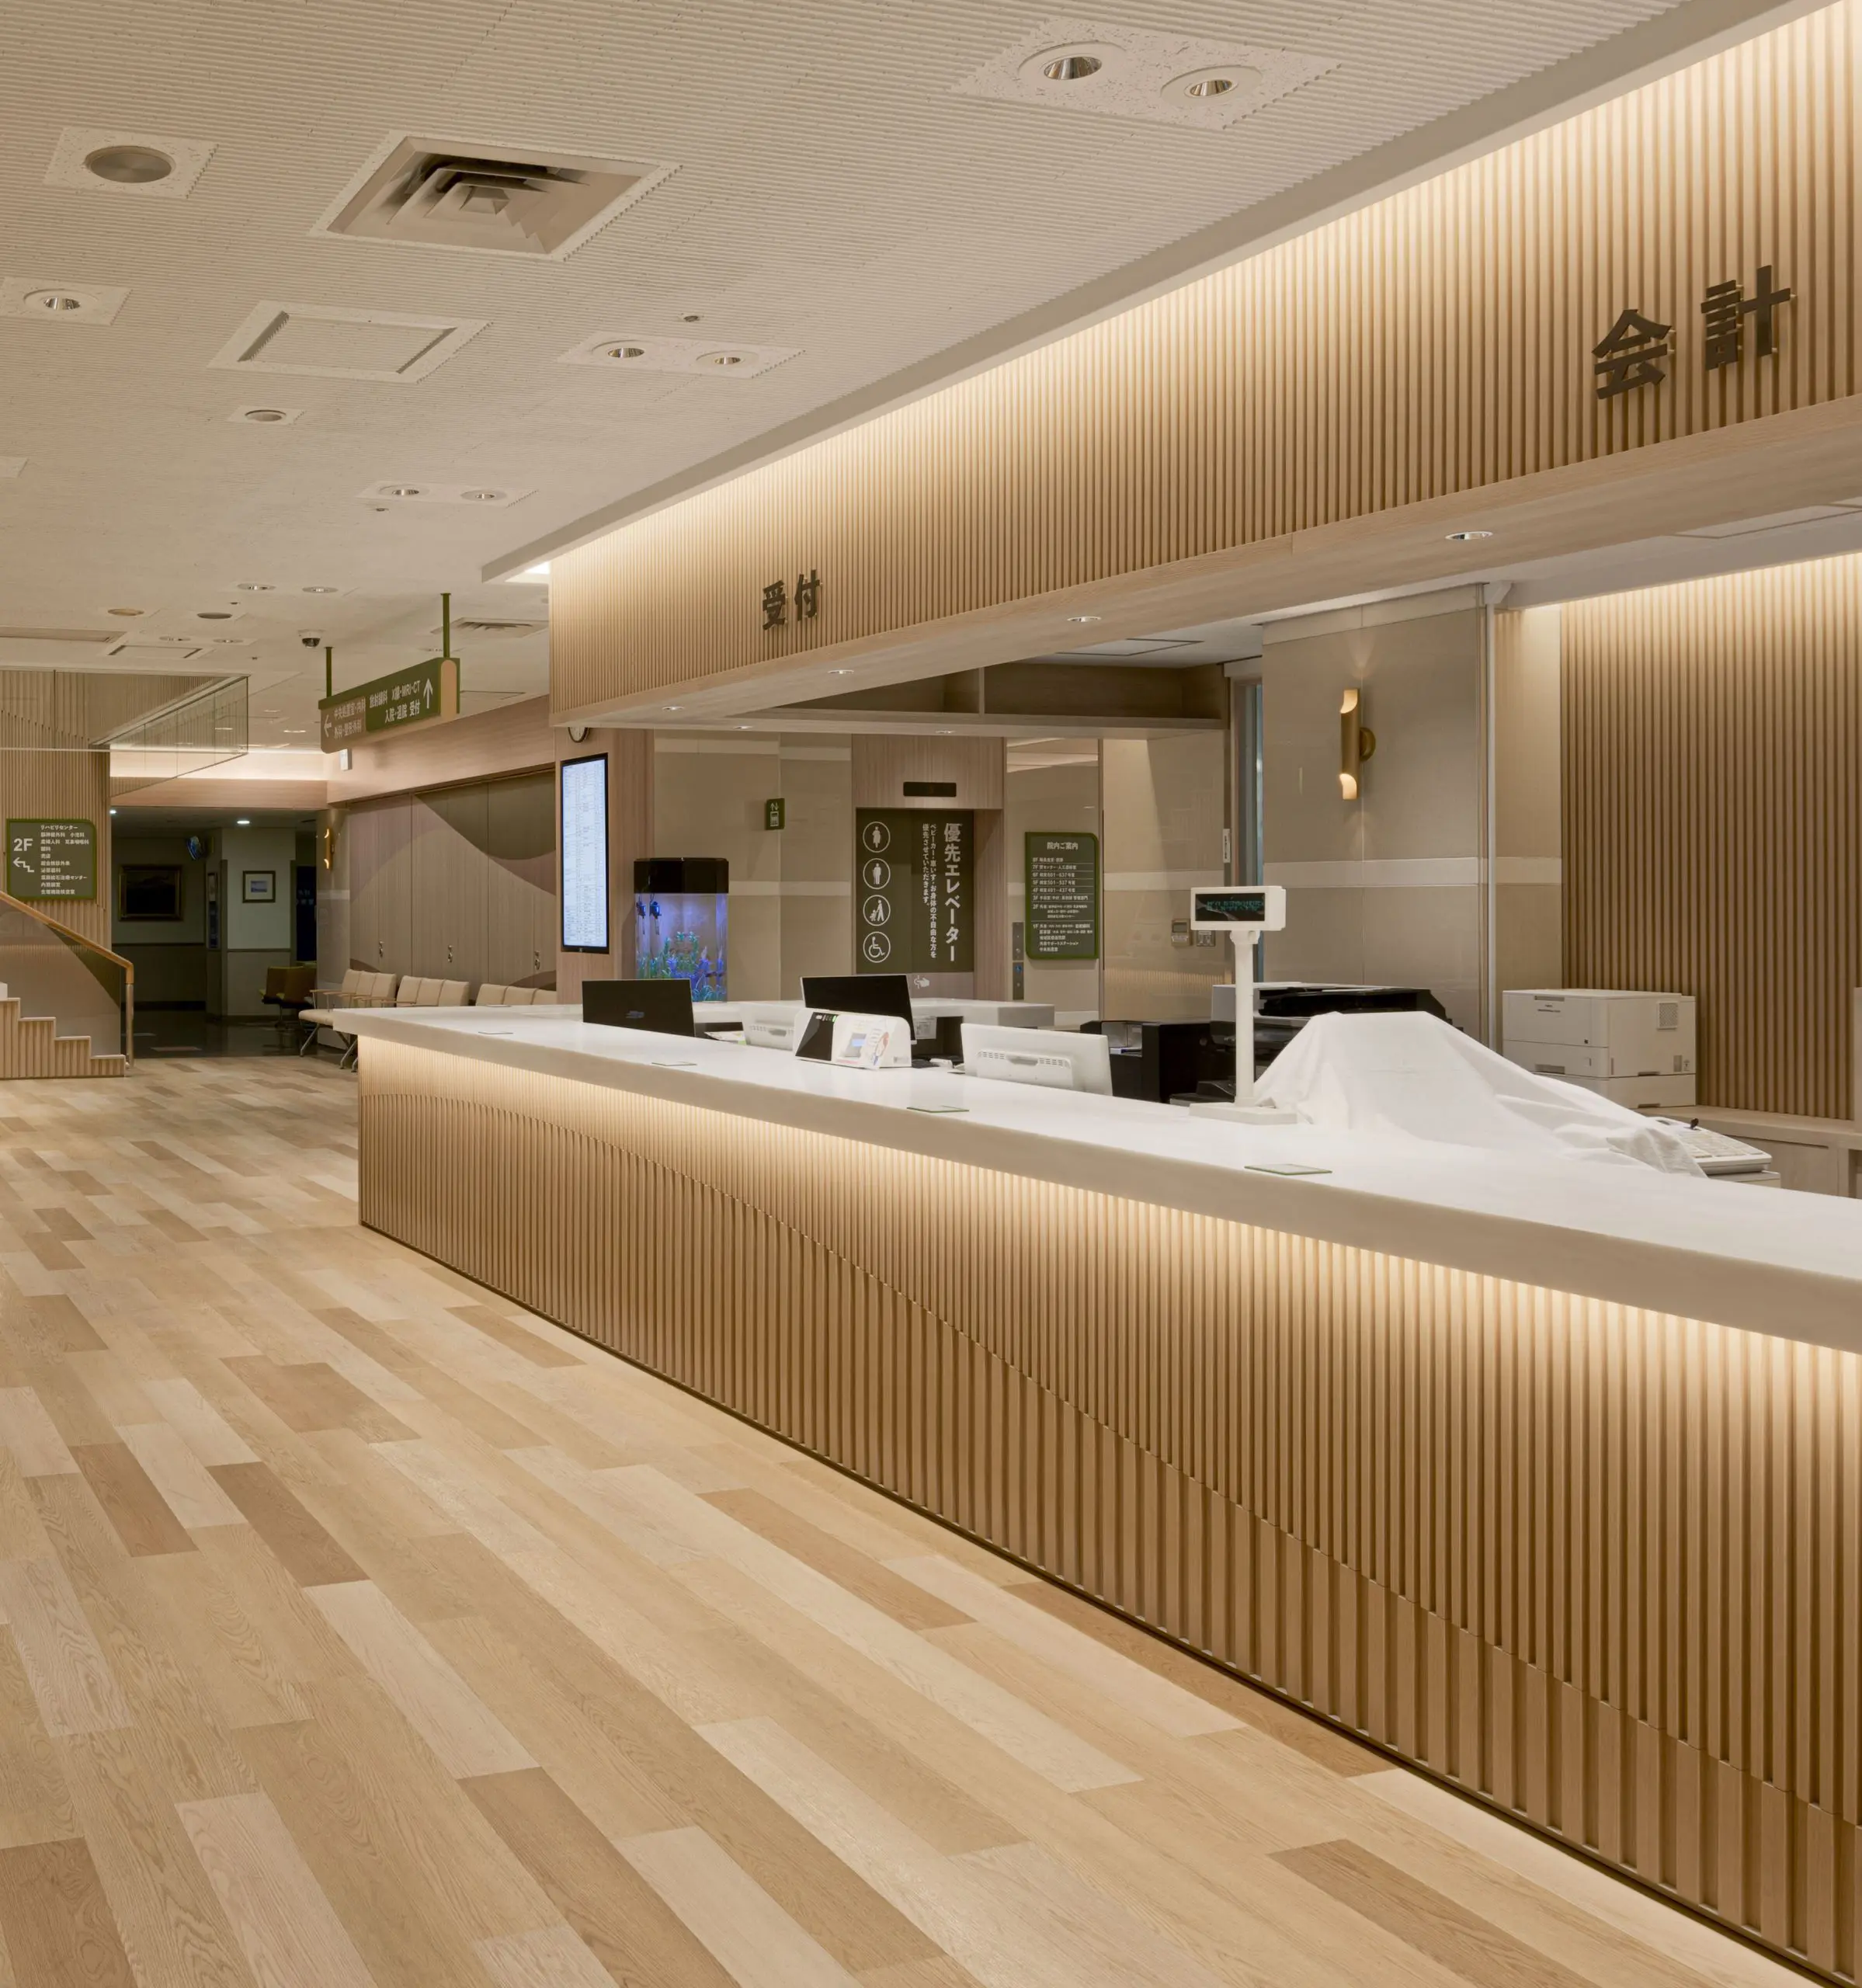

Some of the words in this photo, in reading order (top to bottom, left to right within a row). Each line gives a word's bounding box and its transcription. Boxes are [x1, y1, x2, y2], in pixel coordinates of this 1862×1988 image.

[1592, 265, 1791, 399] 会計
[763, 569, 820, 631] 受付
[13, 838, 33, 852] 2F
[1047, 842, 1079, 850] 院内ご案内
[943, 823, 963, 962] 優先エレベーター
